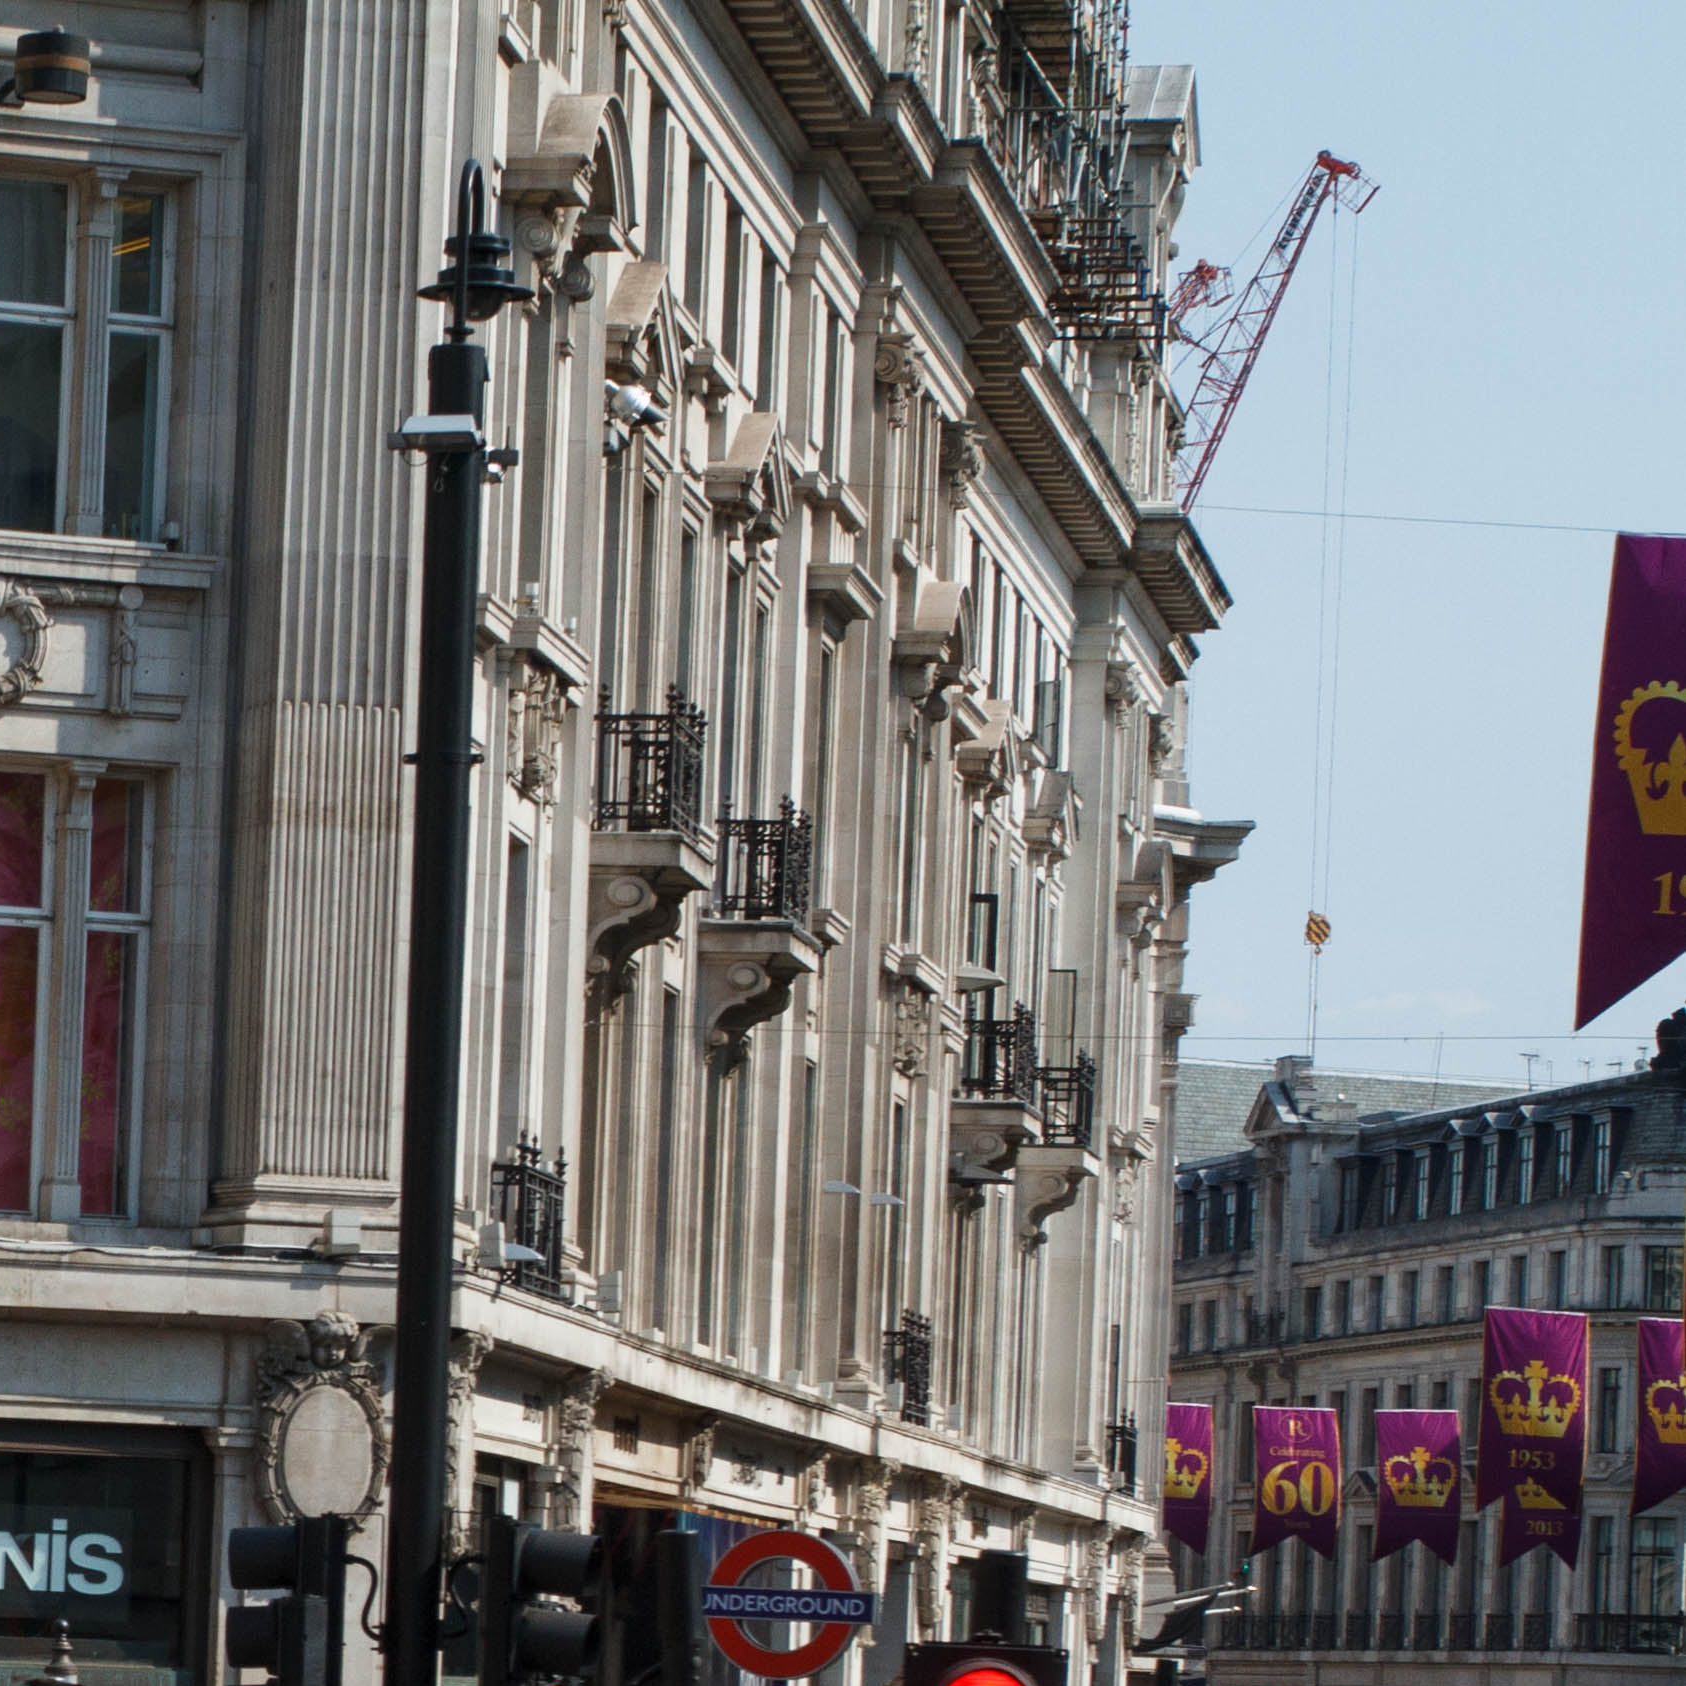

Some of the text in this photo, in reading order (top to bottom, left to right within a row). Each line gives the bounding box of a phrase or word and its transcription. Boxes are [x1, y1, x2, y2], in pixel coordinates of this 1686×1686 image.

[1508, 1448, 1557, 1470] 1953
[1261, 1460, 1334, 1515] 60
[1525, 1520, 1564, 1536] 2013
